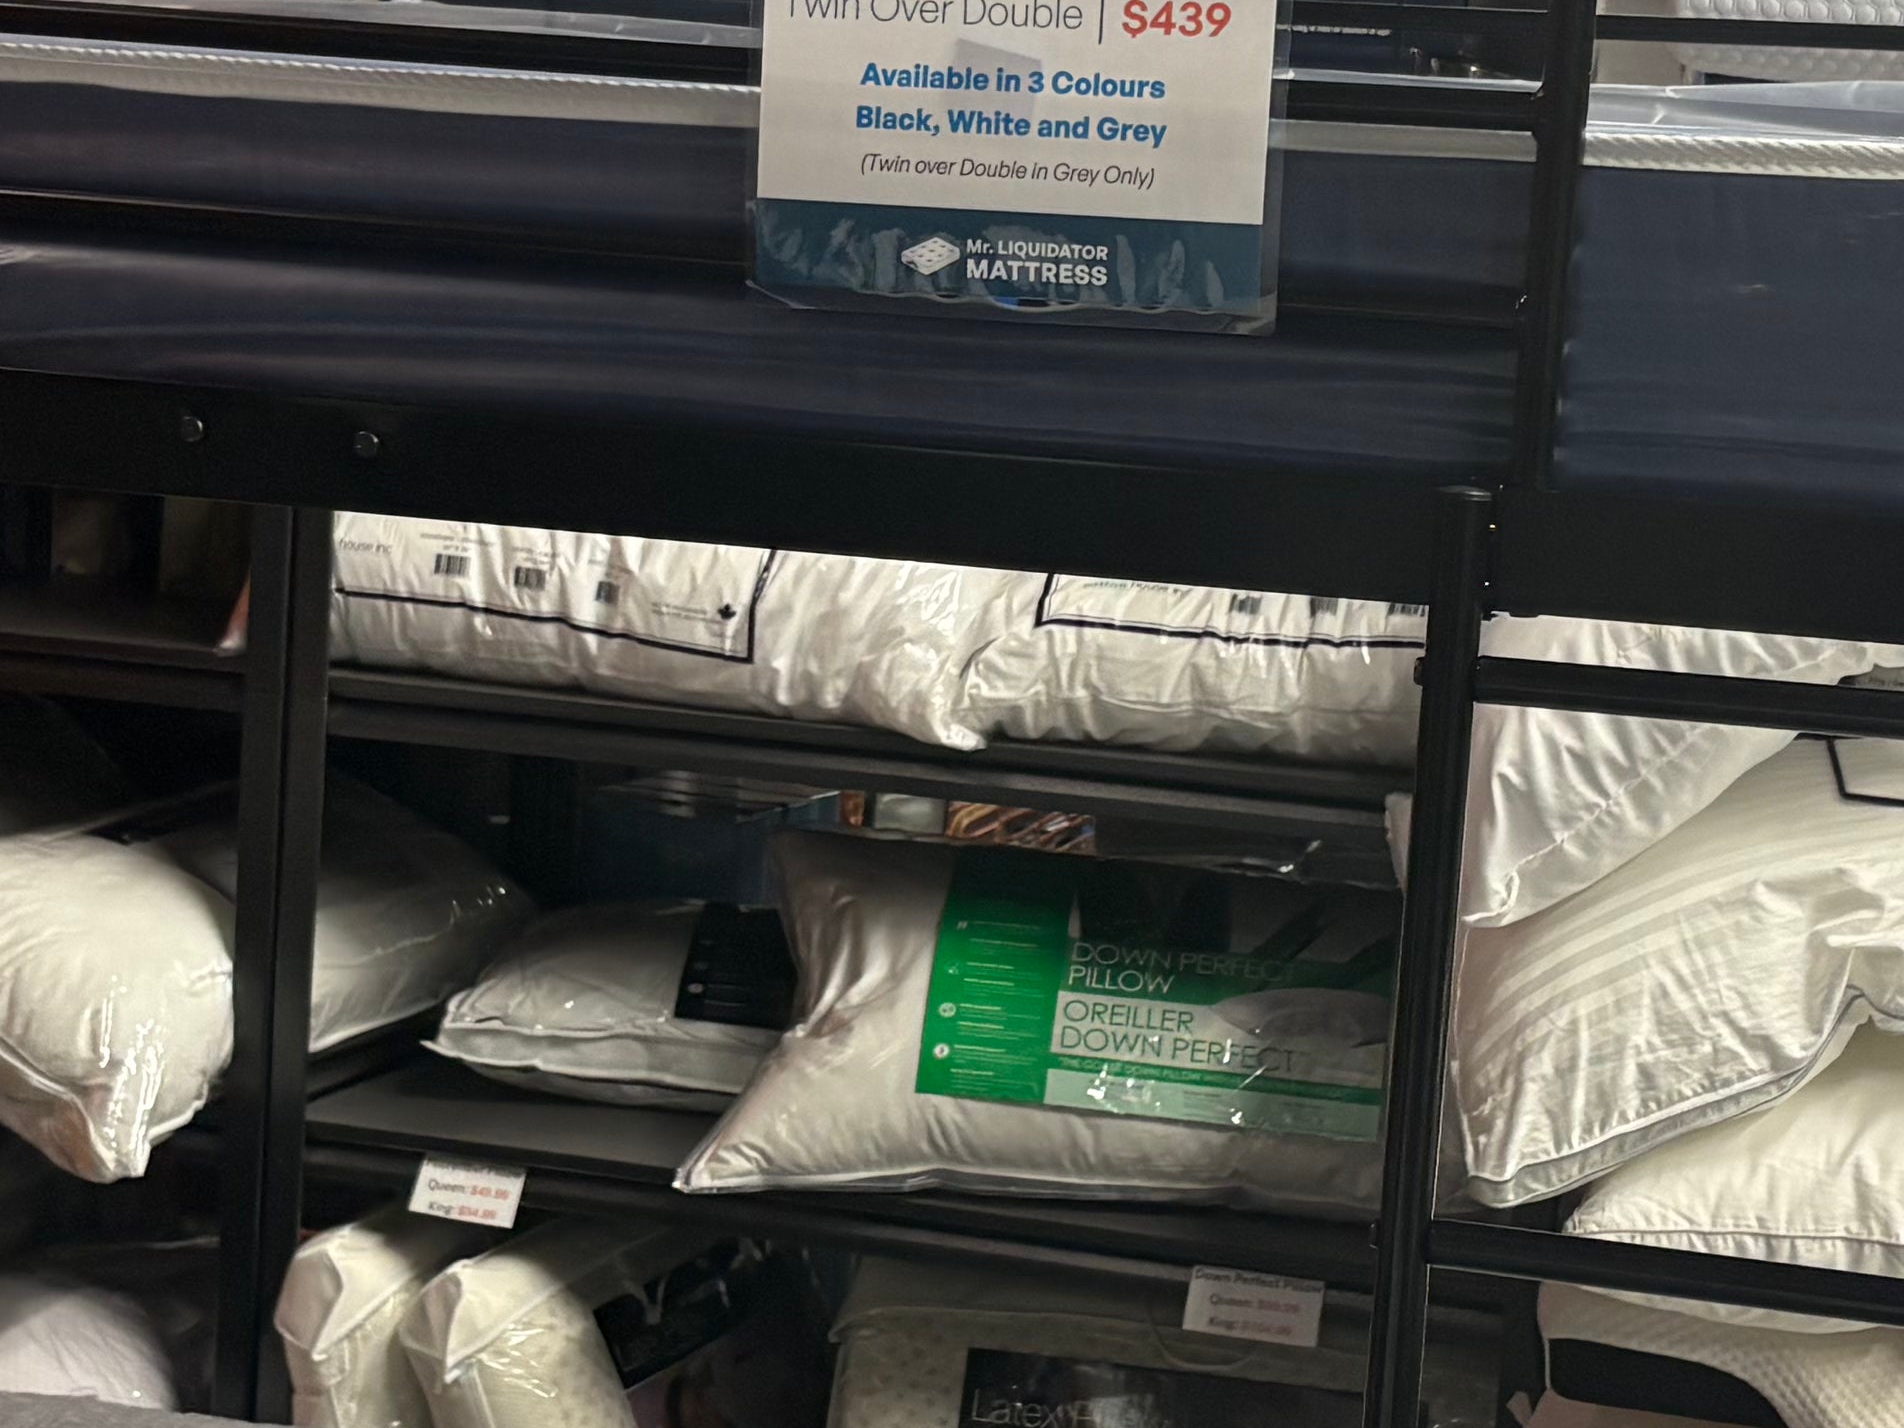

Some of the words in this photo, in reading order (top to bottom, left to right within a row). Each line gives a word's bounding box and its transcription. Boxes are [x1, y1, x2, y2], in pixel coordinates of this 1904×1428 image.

[860, 62, 989, 93] Available
[996, 66, 1021, 94] in
[1027, 69, 1045, 95] 3
[1051, 70, 1166, 99] Colours
[856, 105, 942, 137] Black,
[947, 108, 1031, 138] White
[1037, 111, 1089, 141] and
[1096, 115, 1167, 149] Grey
[860, 153, 911, 177] (Twin
[914, 157, 957, 178] over
[959, 158, 1028, 180] Double
[1031, 162, 1049, 181] in
[1053, 163, 1100, 188] Grey
[1103, 165, 1156, 190] Only)
[965, 238, 994, 256] Mr.
[997, 240, 1109, 262] LIQUIDATOR
[965, 258, 1109, 287] MATTRESS
[1067, 964, 1177, 995] PILLOW
[1070, 941, 1174, 970] DOWN
[1179, 950, 1299, 985] PERFECT
[1062, 998, 1195, 1035] OREILLER
[1058, 1025, 1161, 1058] DOWN
[1171, 1037, 1298, 1074] PERFECT
